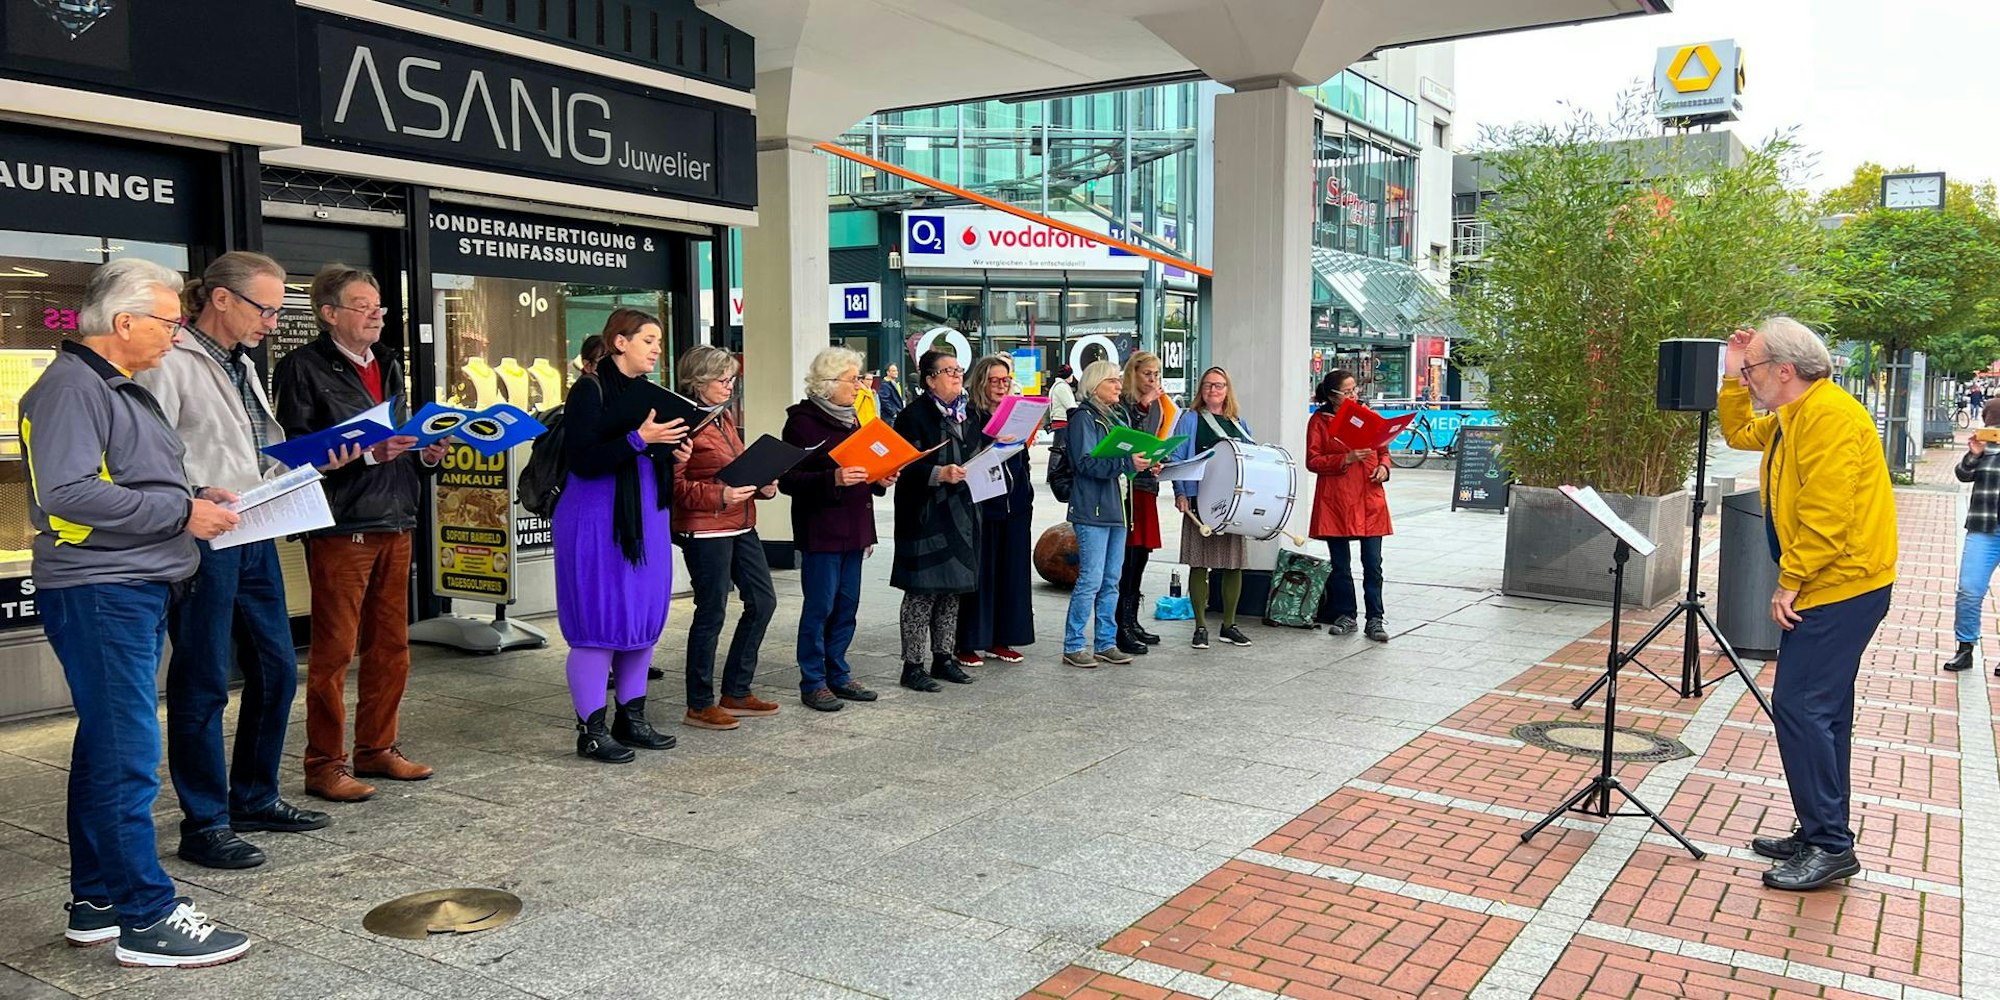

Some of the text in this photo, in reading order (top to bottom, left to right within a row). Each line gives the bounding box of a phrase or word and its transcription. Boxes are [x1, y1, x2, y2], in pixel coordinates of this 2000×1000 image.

[334, 45, 711, 182] ASANG Juwelier
[643, 237, 655, 251] &
[459, 238, 627, 268] STEINFASSUNGEN
[846, 294, 868, 311] 1&1
[277, 336, 309, 345] Samstag
[1164, 341, 1184, 369] 1&1
[441, 444, 505, 471] GOLD
[441, 473, 503, 486] ANKAUF
[446, 529, 501, 545] SOFORT BARGELD
[447, 576, 502, 593] TAGESGOLDPREIS
